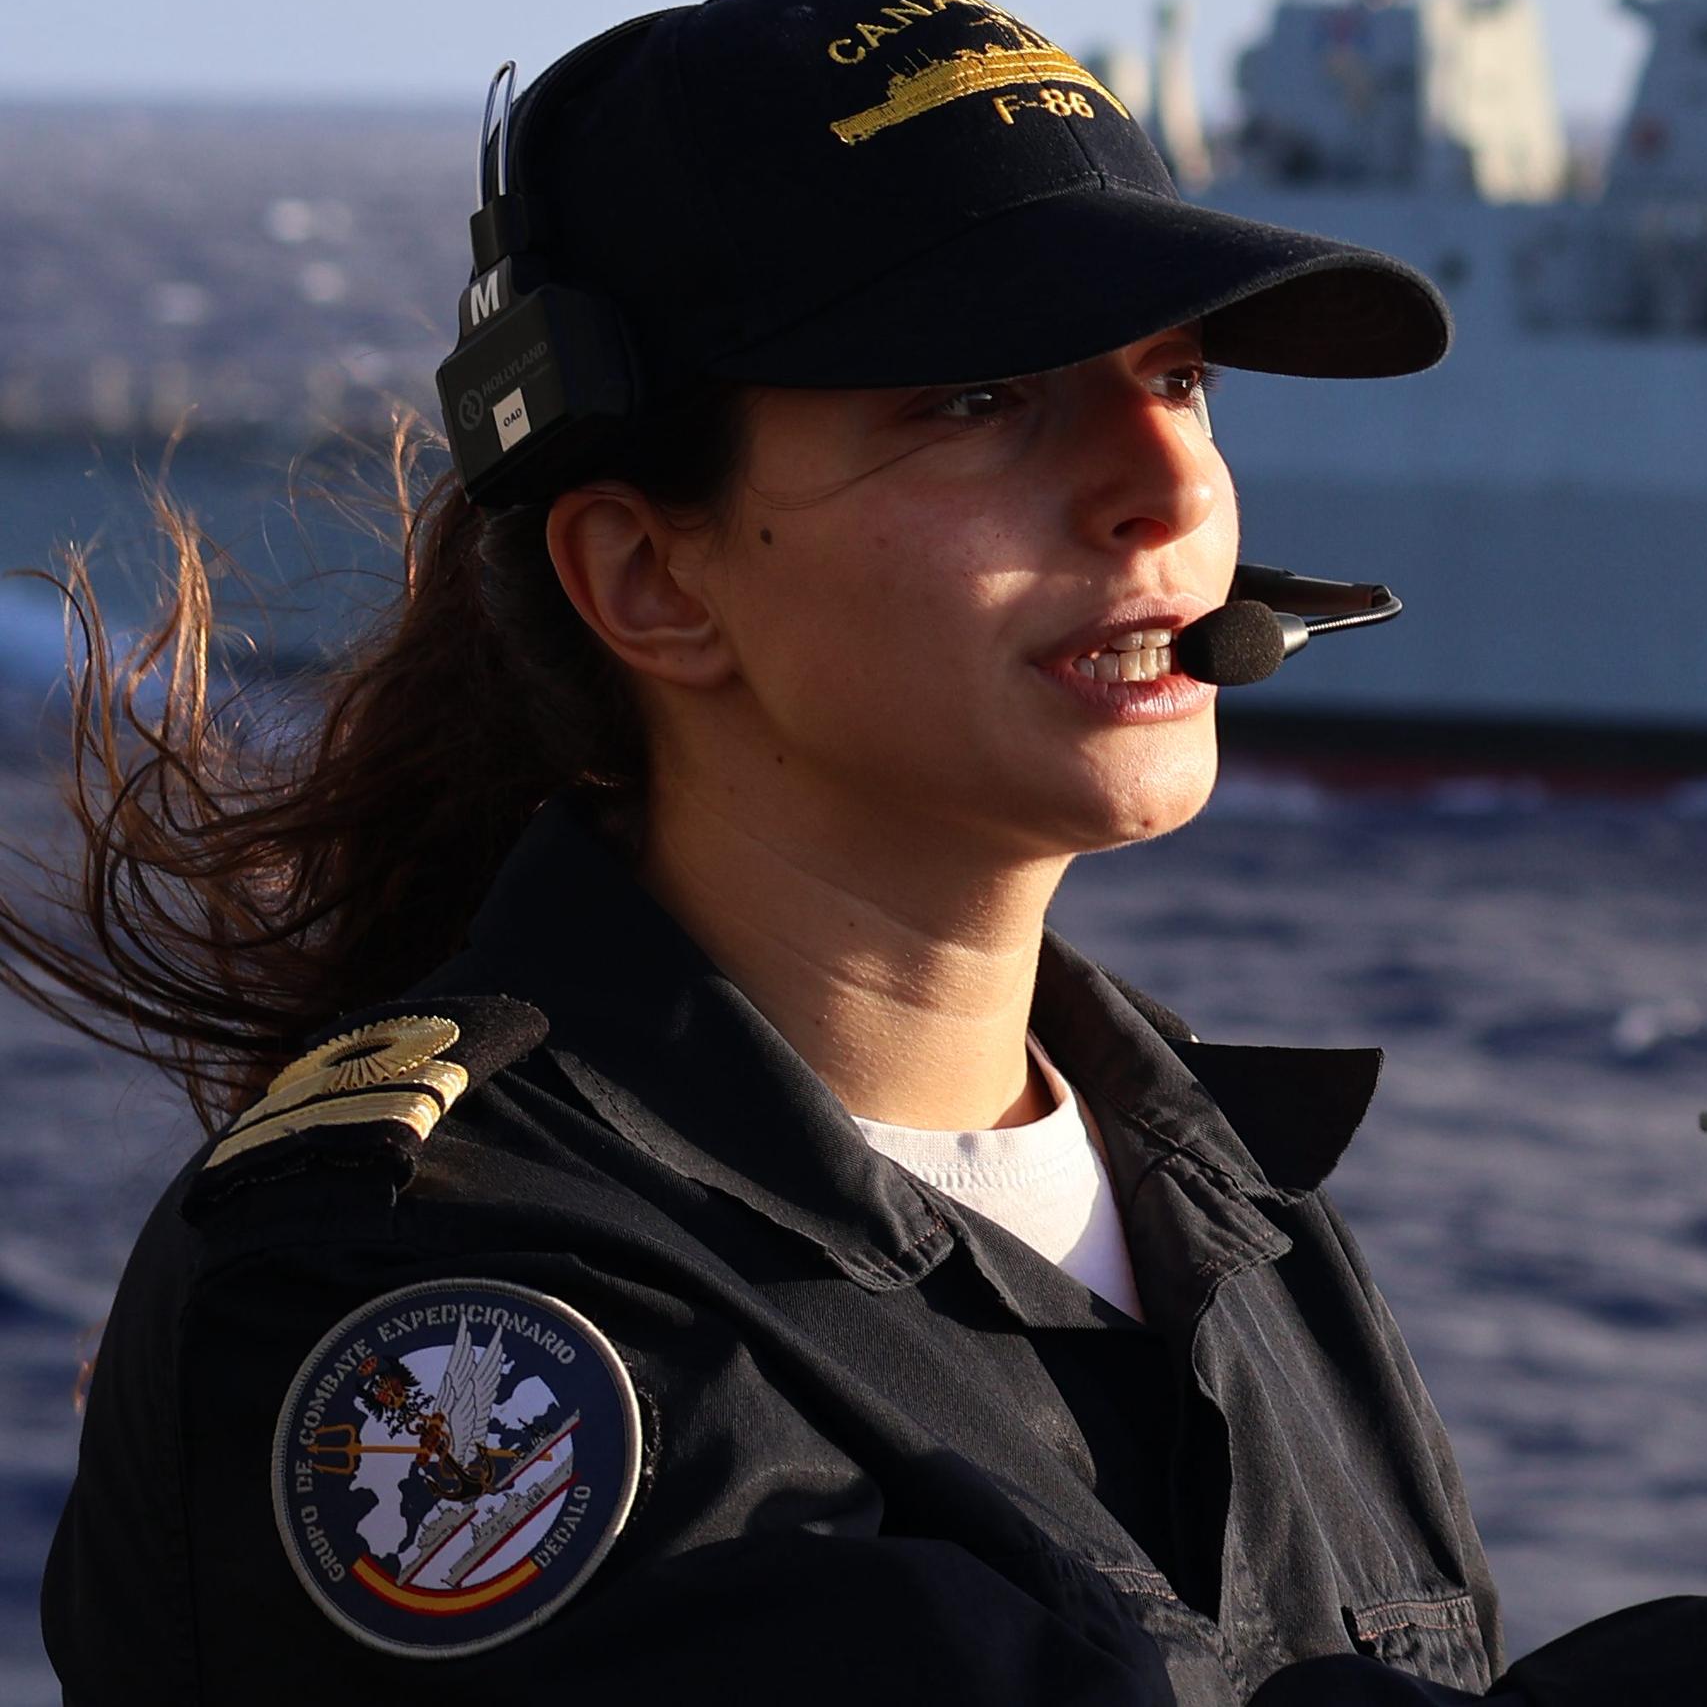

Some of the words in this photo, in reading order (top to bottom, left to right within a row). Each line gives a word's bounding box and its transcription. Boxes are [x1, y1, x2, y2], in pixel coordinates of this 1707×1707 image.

[992, 88, 1095, 125] F-86
[470, 269, 500, 327] M
[481, 341, 549, 397] HOLLYLAND
[503, 407, 523, 428] OAD
[376, 1303, 577, 1365] EXPEDICIONARIO
[298, 1338, 374, 1447] COMBATE
[296, 1459, 314, 1494] DE
[300, 1504, 346, 1583] GRUPO
